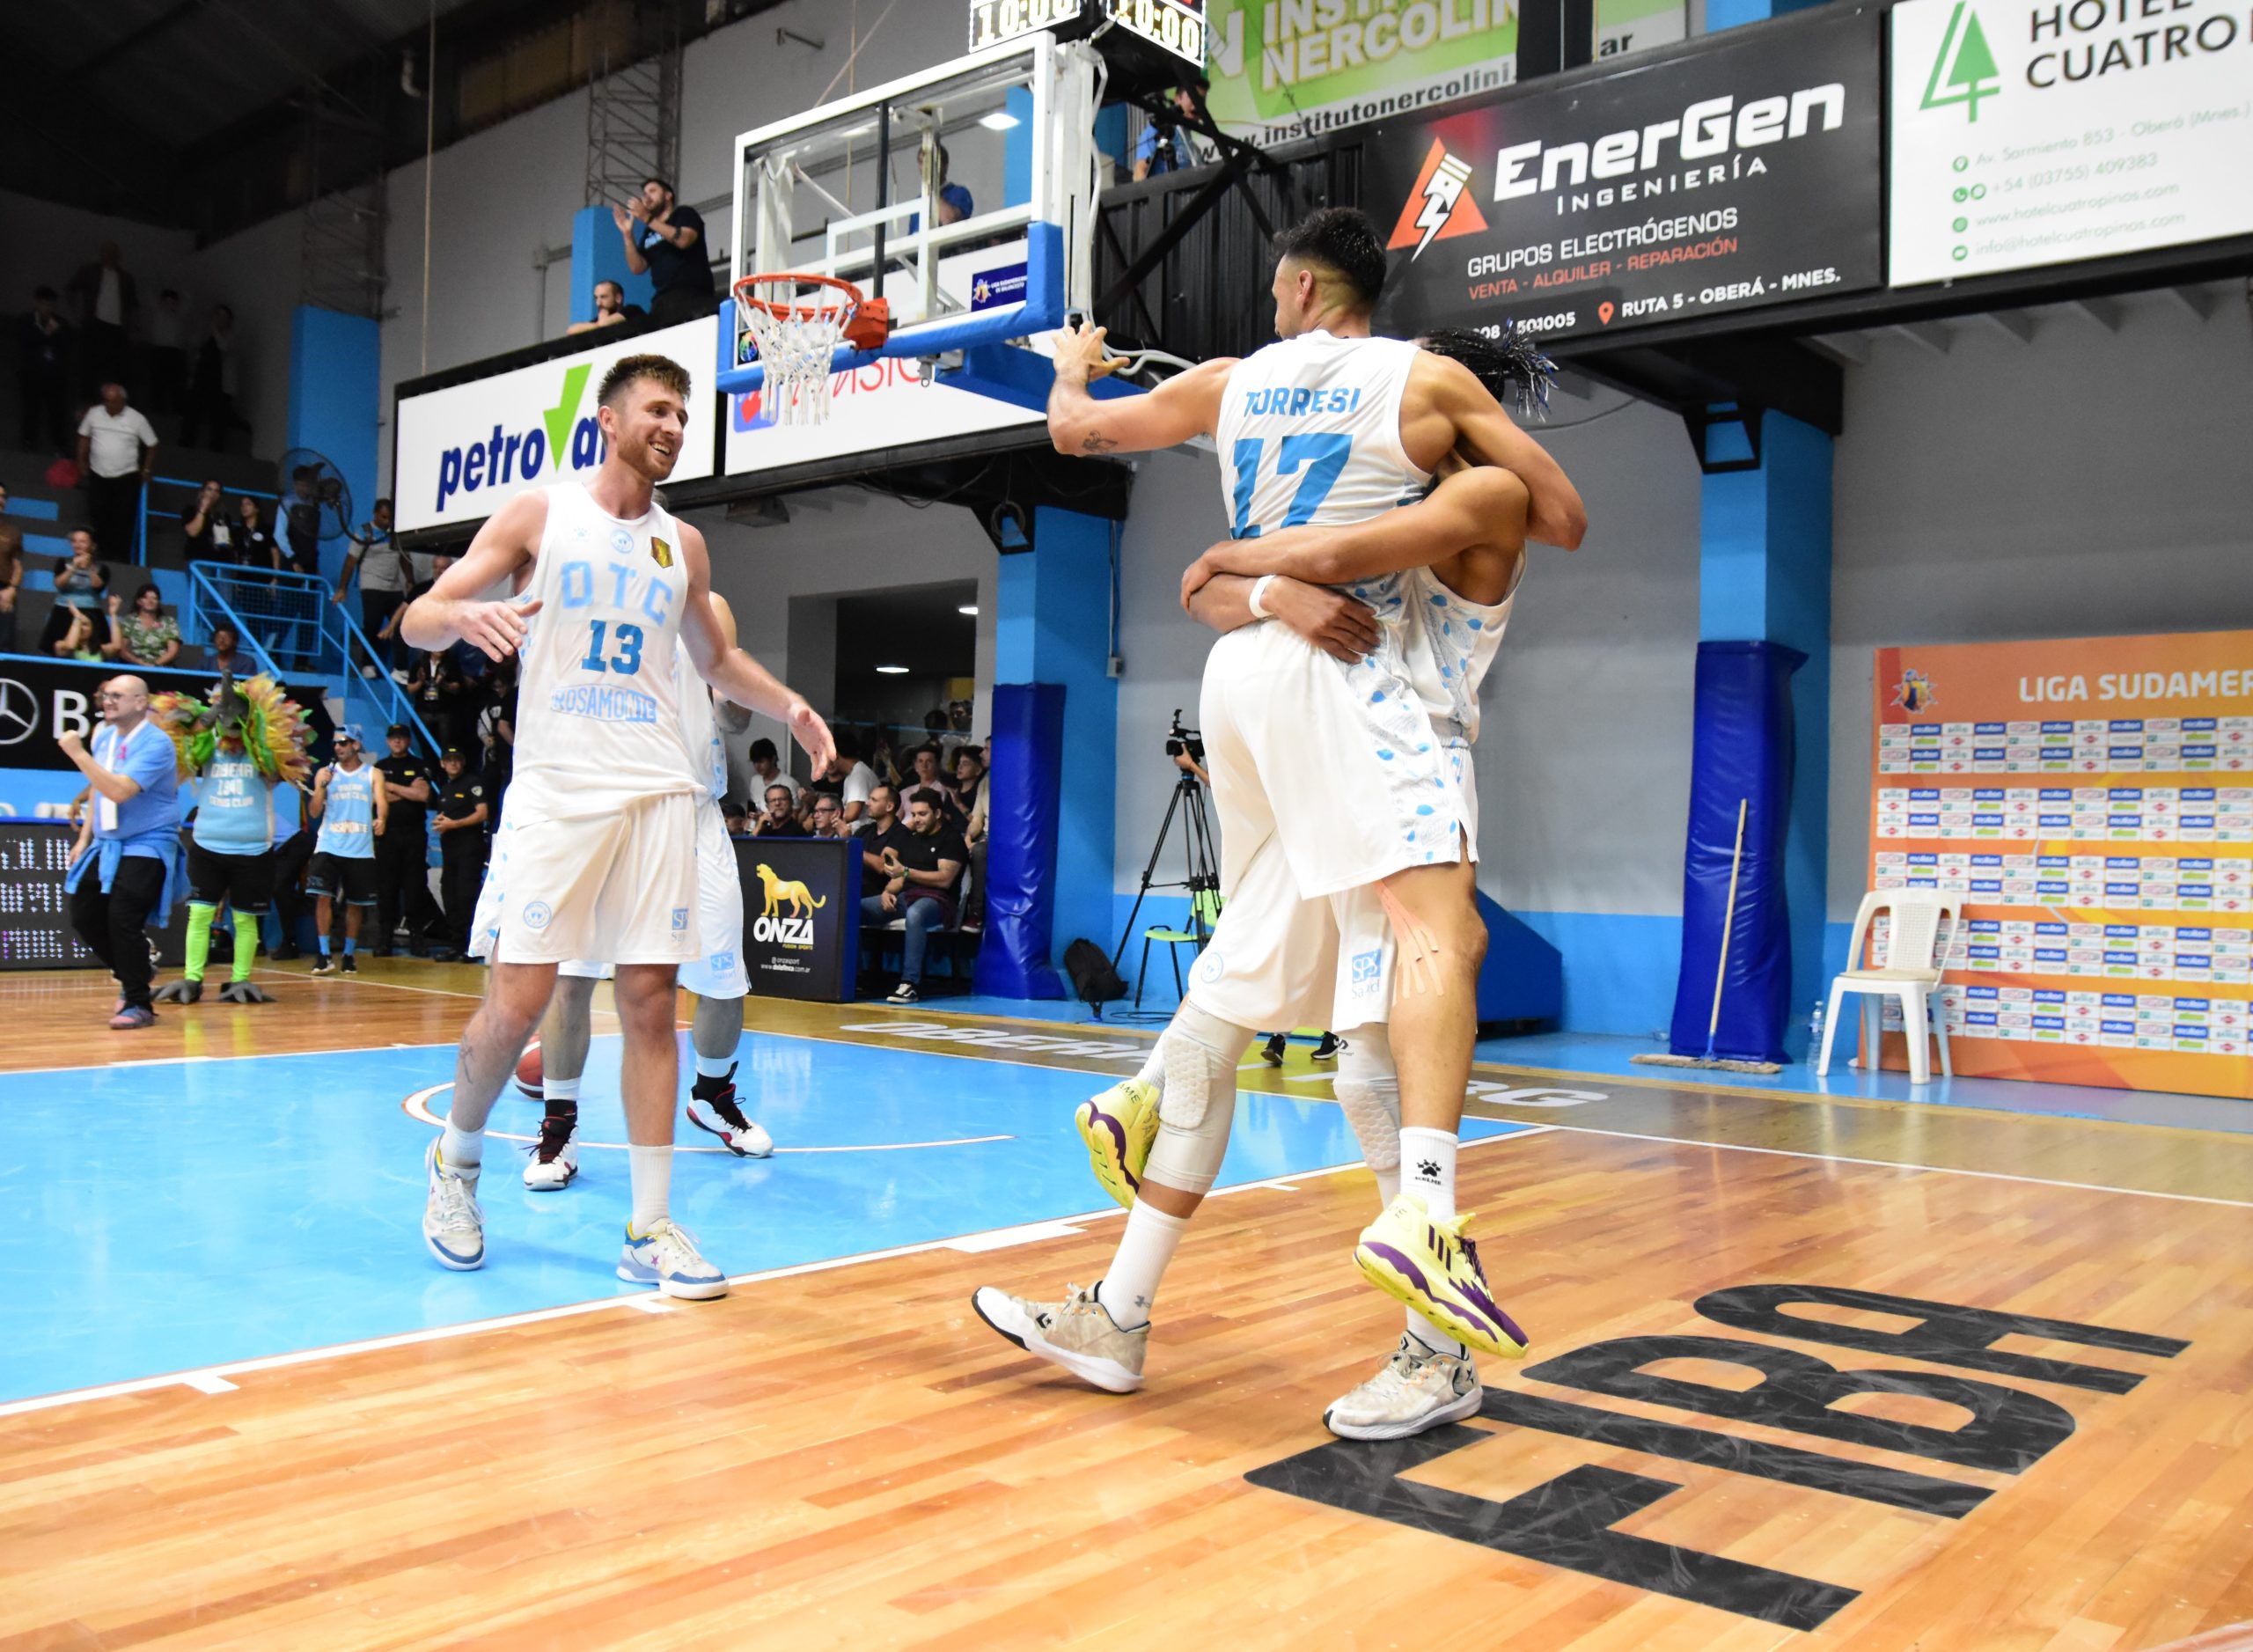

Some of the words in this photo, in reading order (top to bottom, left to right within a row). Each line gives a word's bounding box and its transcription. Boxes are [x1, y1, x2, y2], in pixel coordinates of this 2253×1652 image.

[2027, 13, 2237, 88] CUATRO
[1493, 83, 1846, 202] EnerGen
[2003, 136, 2077, 162] Sarmiento
[2083, 127, 2114, 146] 853
[2029, 165, 2090, 189] (03755)
[2095, 152, 2157, 175] 409383
[1557, 154, 1767, 216] INGENIERÍA
[1468, 243, 1553, 277] GRUPOS
[1560, 207, 1738, 261] ELECTRÓGENOS
[1468, 275, 1518, 301] VENTA
[1533, 261, 1611, 289] ALQUILER
[1627, 236, 1738, 271] REPARACIÓN
[1517, 312, 1575, 335] 501005
[1622, 296, 1669, 318] RUTA
[1672, 293, 1684, 309] 5
[1699, 276, 1765, 305] OBERÁ
[1782, 267, 1841, 291] MNES.
[1244, 387, 1361, 418] TORRESI
[1230, 432, 1354, 540] 17
[561, 561, 673, 628] OTC
[582, 619, 644, 675] 13
[2019, 675, 2089, 702] LIGA
[753, 915, 814, 945] ONZA
[1244, 1282, 2191, 1632] FIBA
